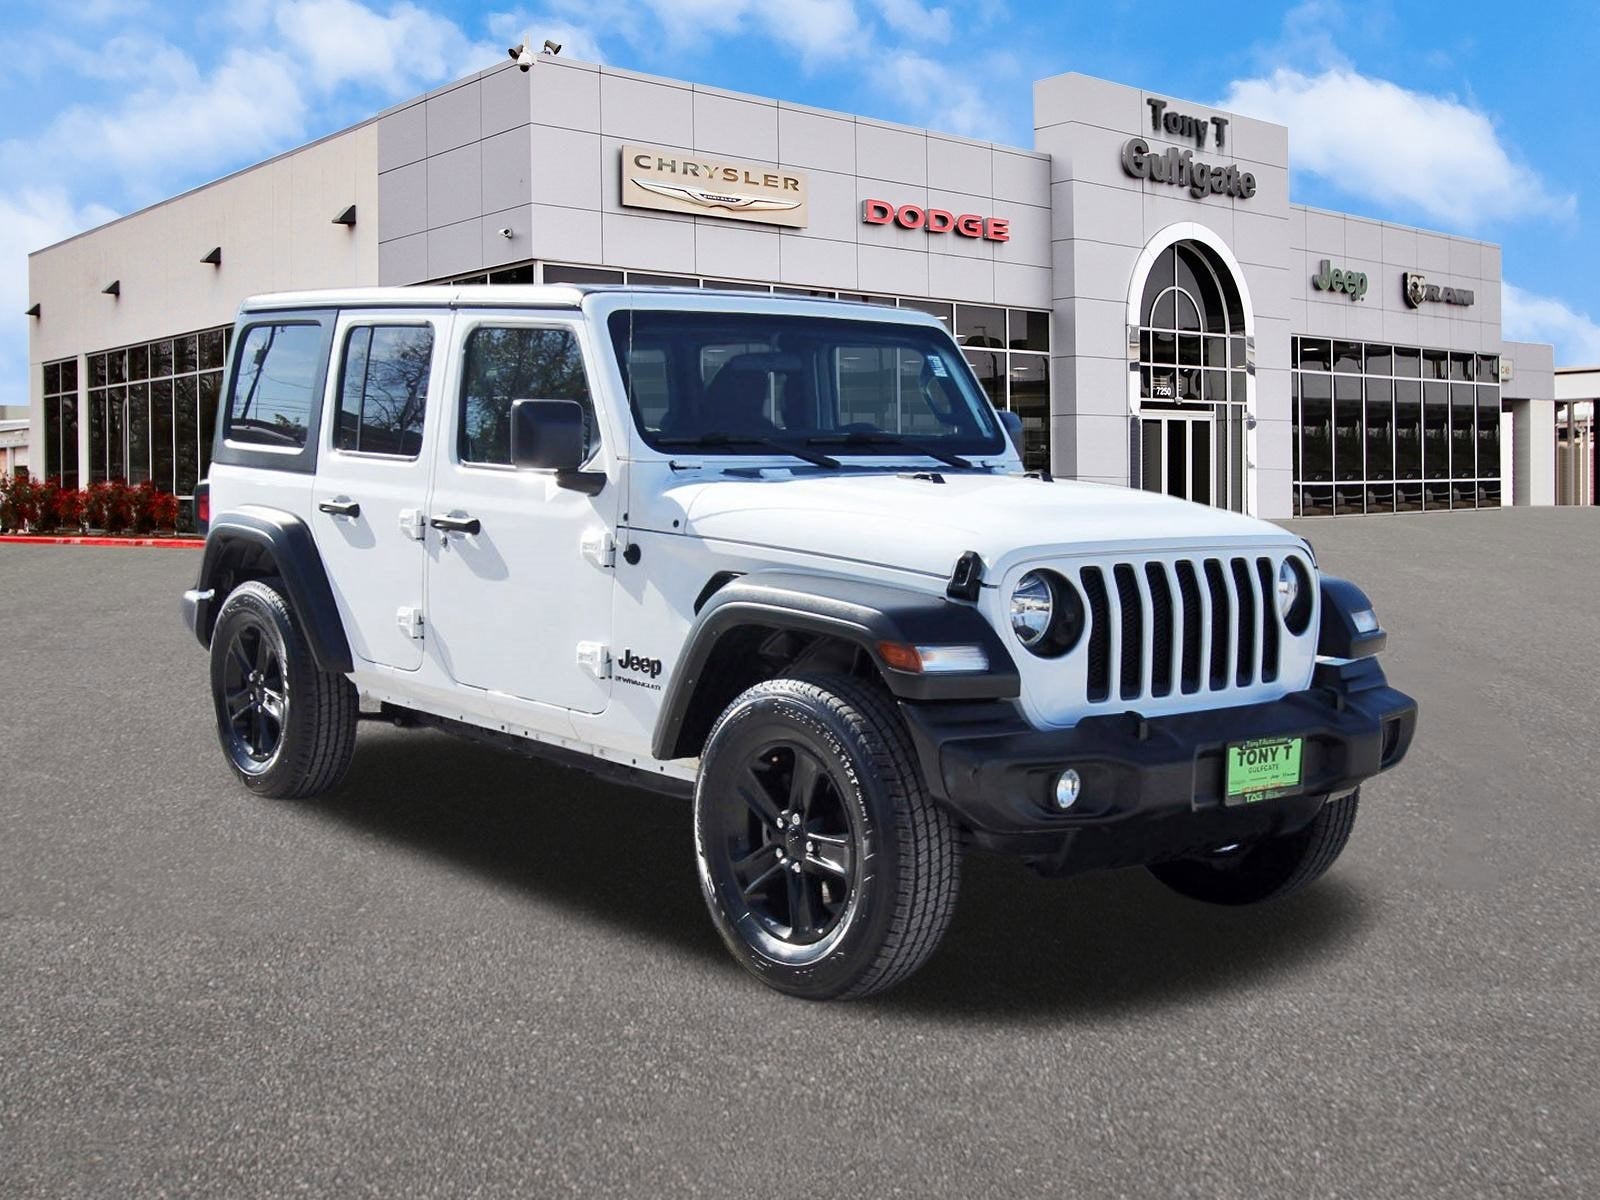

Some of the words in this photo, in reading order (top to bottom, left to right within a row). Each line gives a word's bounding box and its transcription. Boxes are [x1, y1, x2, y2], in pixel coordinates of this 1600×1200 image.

[1146, 98, 1209, 148] Tony
[1210, 116, 1229, 147] T
[633, 153, 801, 192] CHRYSLER
[1121, 138, 1257, 199] Gulfgate
[862, 199, 1010, 242] DODGE
[1312, 259, 1368, 302] Jeep
[1424, 283, 1475, 307] RAM
[1156, 386, 1172, 396] 7250
[618, 649, 662, 679] Jeep
[1237, 746, 1279, 767] TONY
[1284, 745, 1293, 760] T
